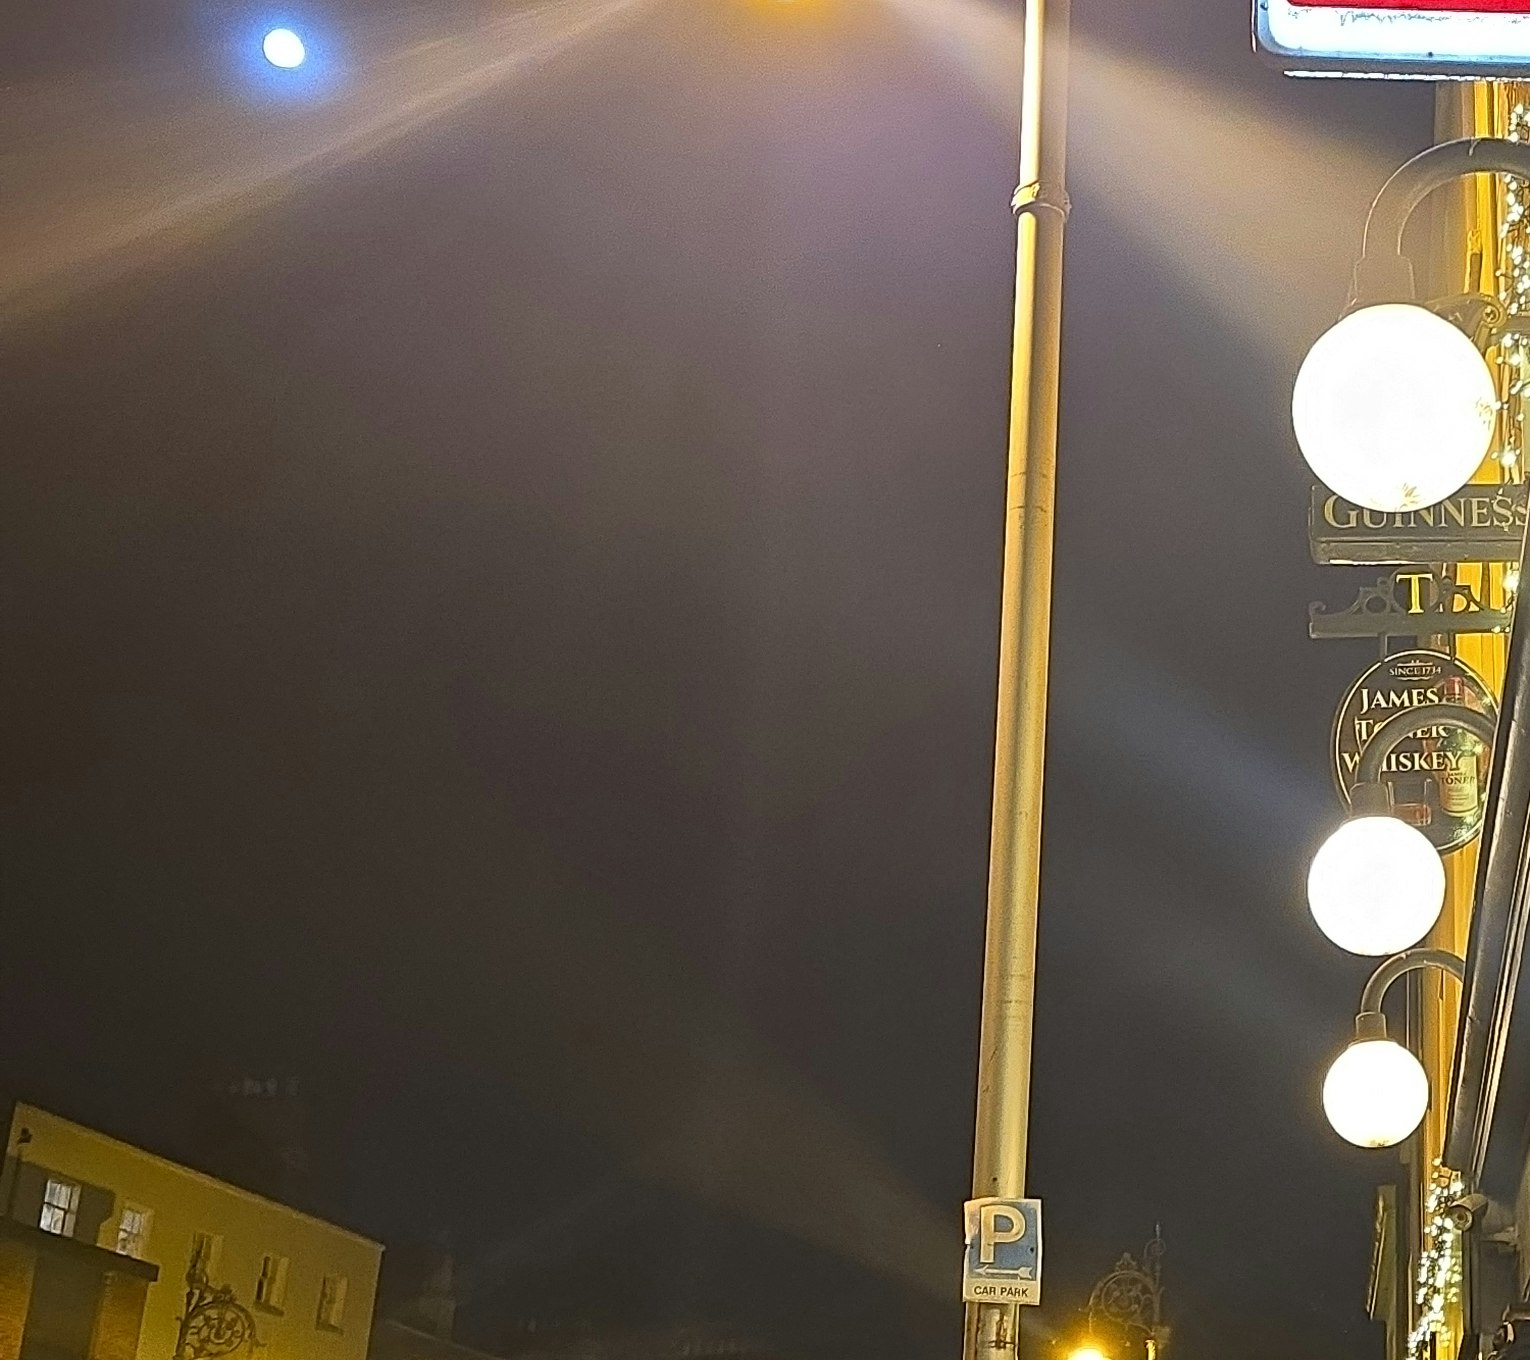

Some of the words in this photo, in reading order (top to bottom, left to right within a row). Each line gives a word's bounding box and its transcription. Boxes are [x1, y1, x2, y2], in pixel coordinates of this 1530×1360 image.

[1359, 687, 1440, 715] JAMES
[979, 1204, 1026, 1264] P
[973, 1285, 996, 1296] CAR
[1000, 1286, 1029, 1297] PARK
